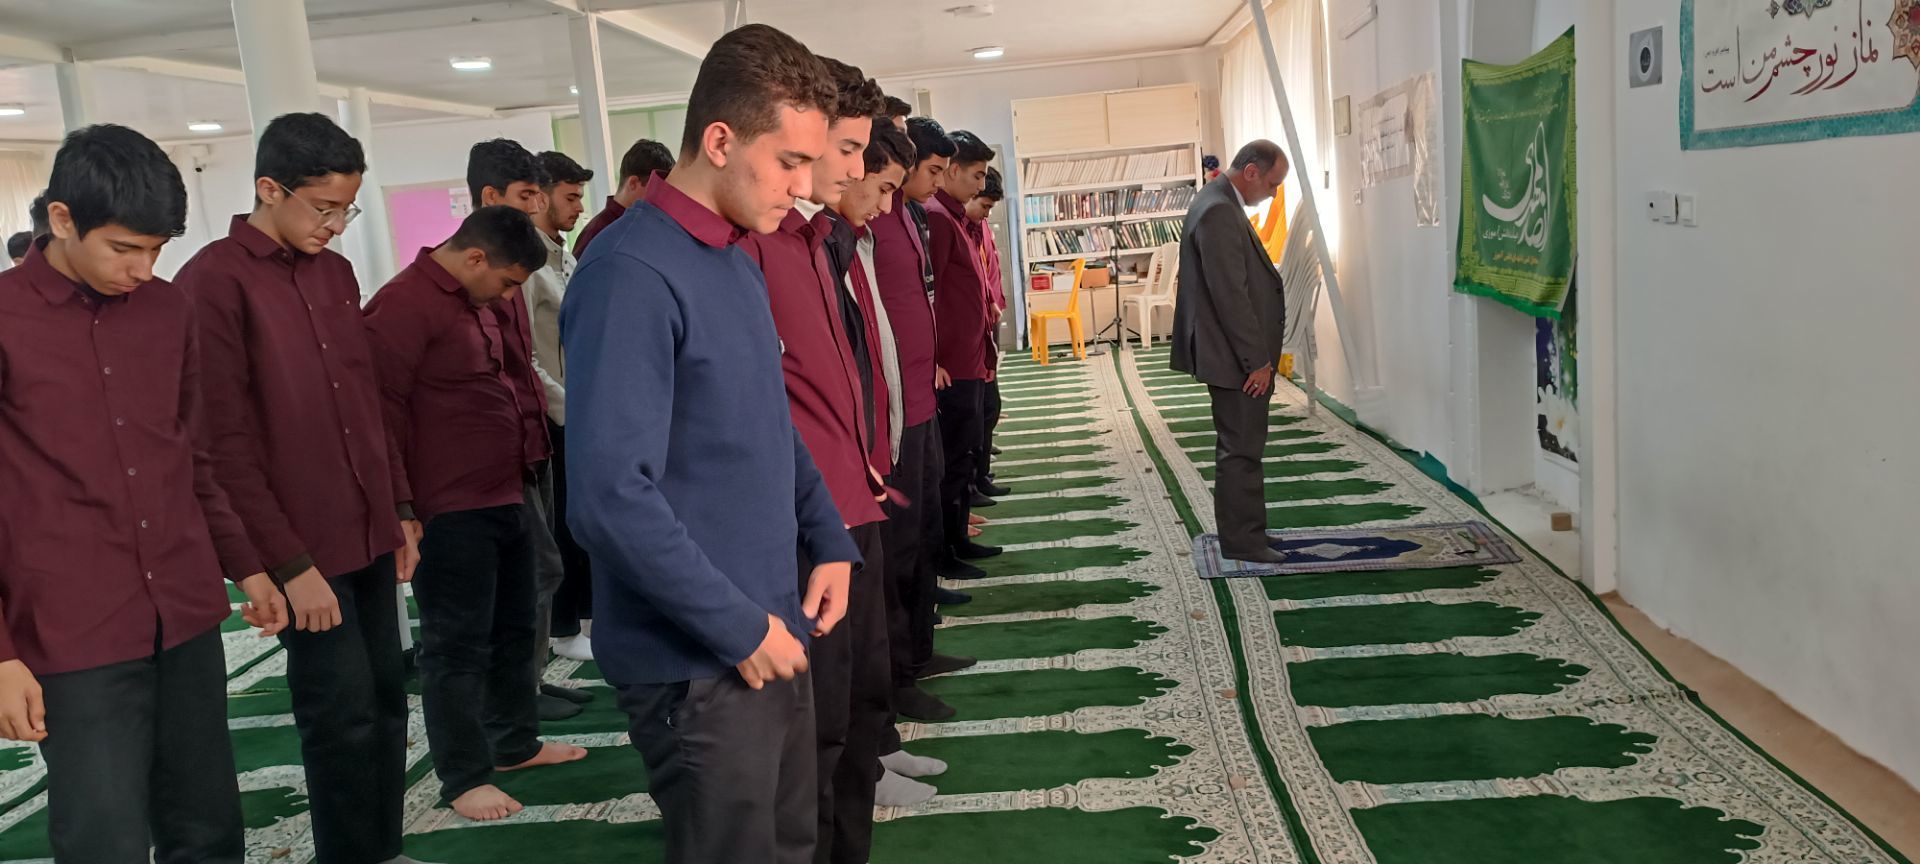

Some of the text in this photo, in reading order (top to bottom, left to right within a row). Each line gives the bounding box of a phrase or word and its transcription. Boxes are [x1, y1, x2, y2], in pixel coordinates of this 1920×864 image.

[1701, 0, 1879, 103] نماز نور چشم من است
